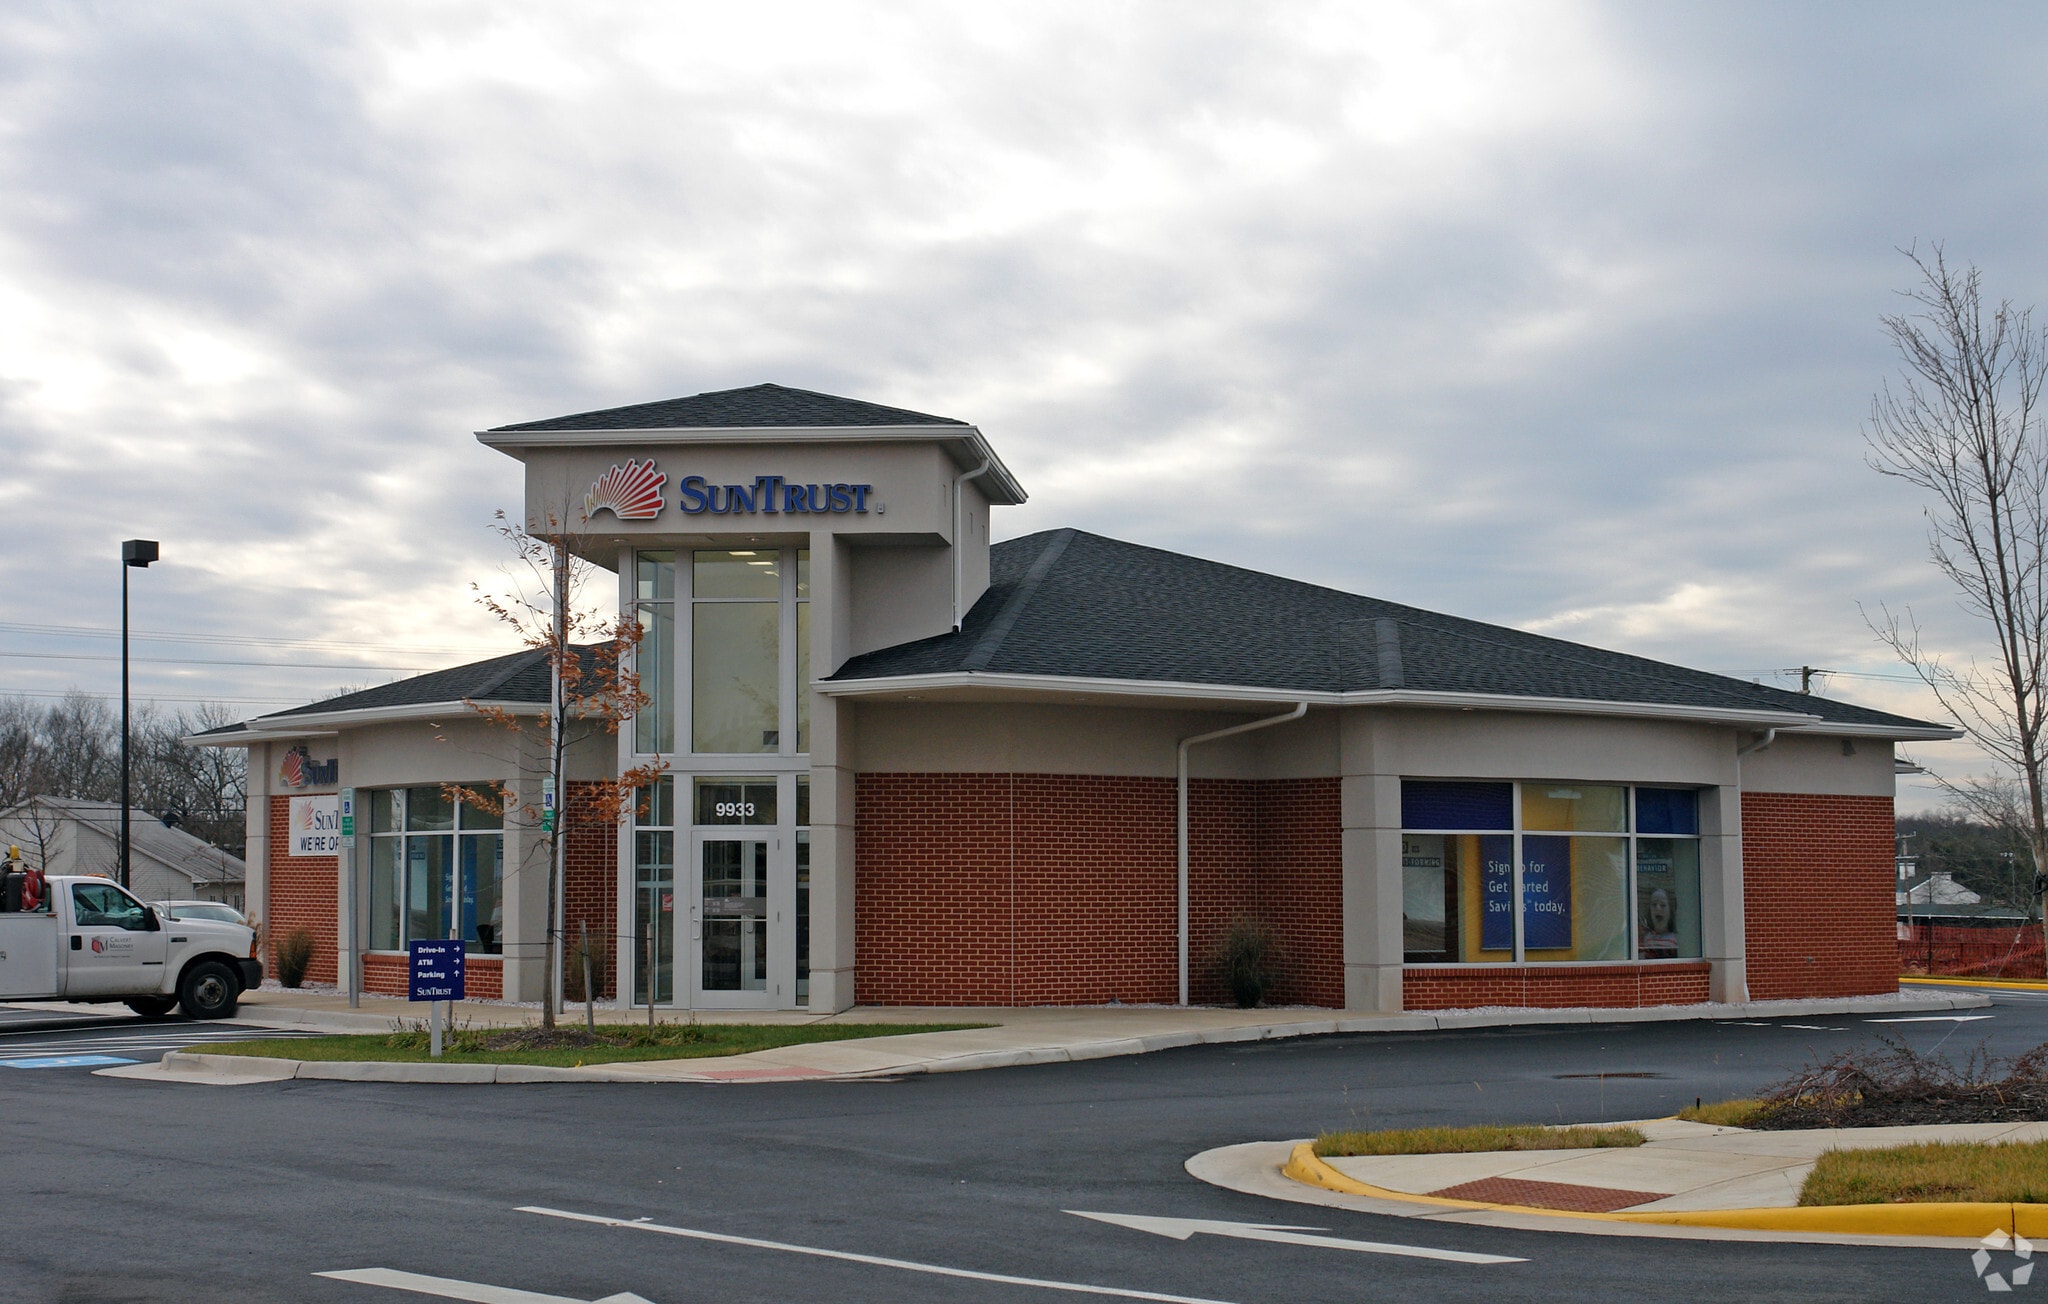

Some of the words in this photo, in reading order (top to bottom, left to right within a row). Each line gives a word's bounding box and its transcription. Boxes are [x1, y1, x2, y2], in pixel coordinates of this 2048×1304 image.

[680, 475, 872, 514] SUNTRUST
[715, 802, 755, 817] 9933
[300, 836, 326, 851] WE'RE
[1488, 860, 1511, 876] Sign
[1529, 860, 1545, 873] for
[1488, 880, 1508, 893] Get
[1522, 880, 1549, 893] arted
[1489, 900, 1527, 912] Savis
[1534, 900, 1566, 915] today.
[417, 958, 434, 966] ATM
[417, 970, 446, 979] Parking
